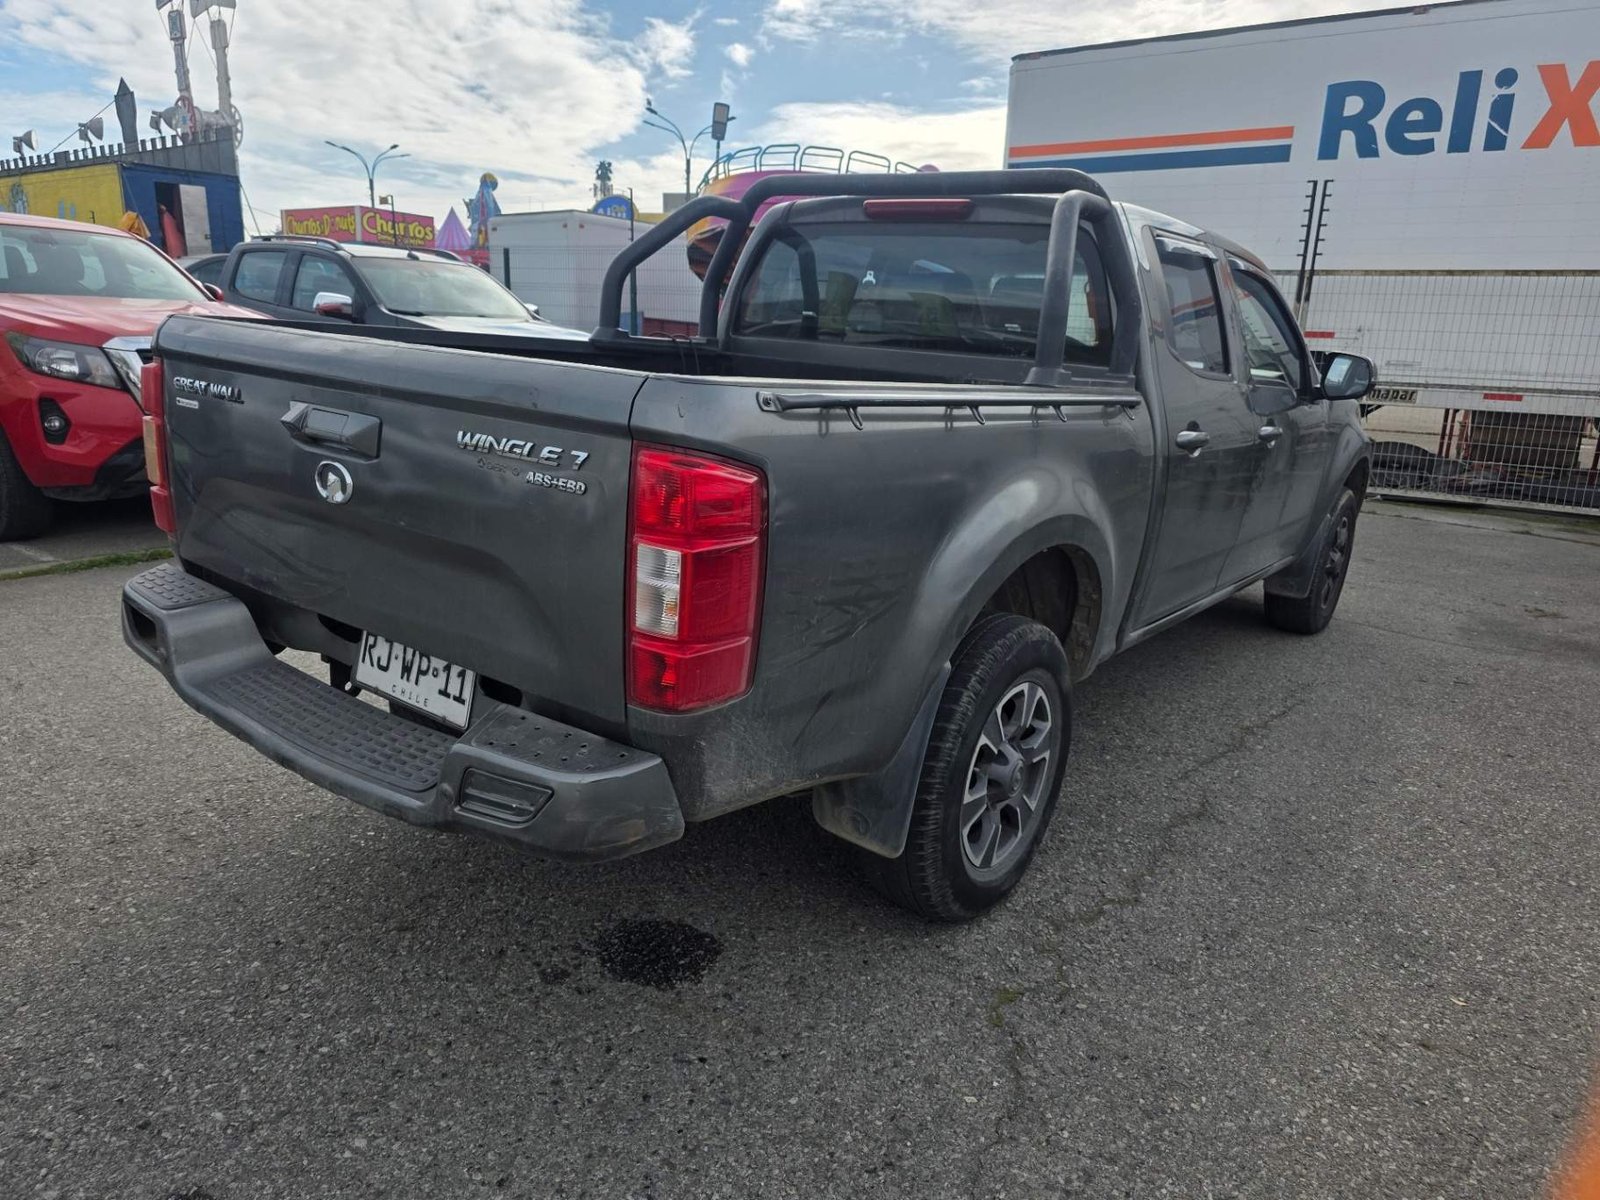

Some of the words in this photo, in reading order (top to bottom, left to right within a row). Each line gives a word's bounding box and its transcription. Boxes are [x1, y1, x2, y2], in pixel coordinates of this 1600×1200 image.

[362, 211, 434, 241] Churros
[173, 376, 208, 396] GREAT
[208, 382, 245, 404] WALL
[457, 430, 563, 467] WINGLE
[570, 450, 590, 470] 7
[526, 471, 587, 495] ABS+EBD
[391, 684, 429, 707] CHILE
